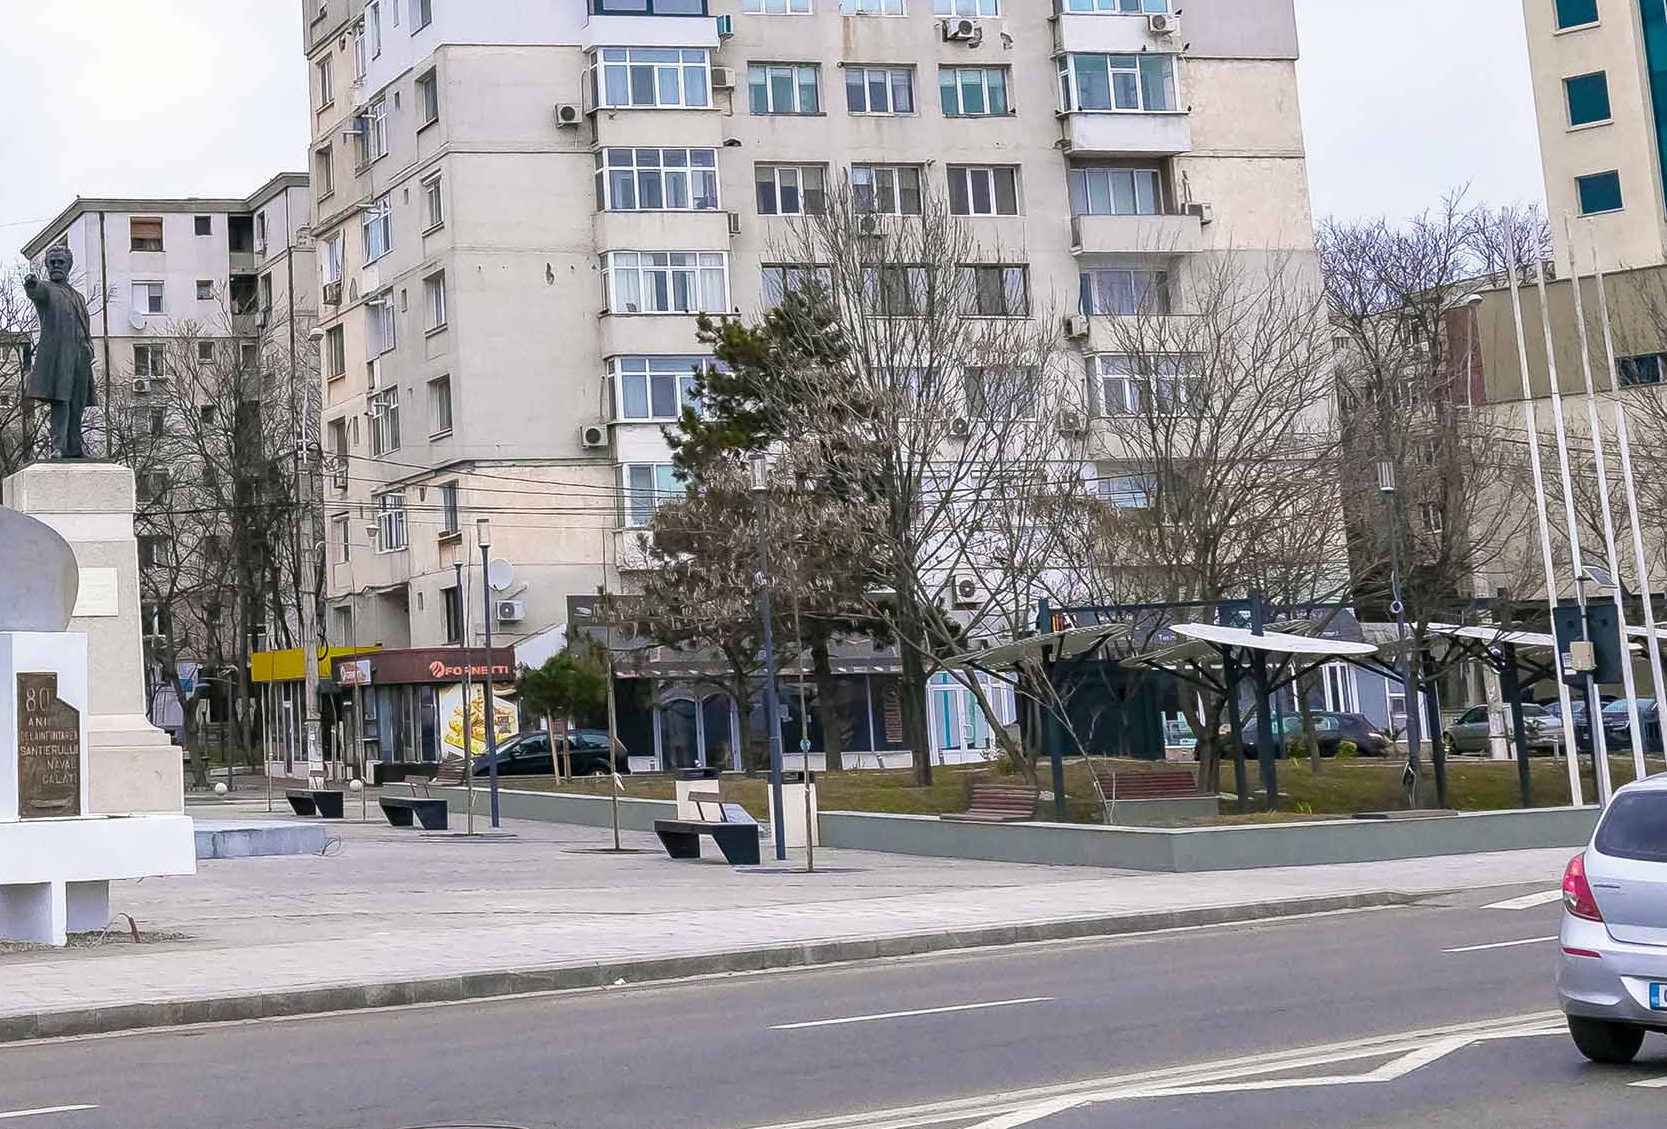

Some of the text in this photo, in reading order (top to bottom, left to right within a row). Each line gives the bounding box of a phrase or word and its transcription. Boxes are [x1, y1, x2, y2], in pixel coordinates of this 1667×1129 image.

[25, 687, 50, 711] 80
[28, 717, 47, 728] ANI
[47, 758, 77, 770] NAVAL
